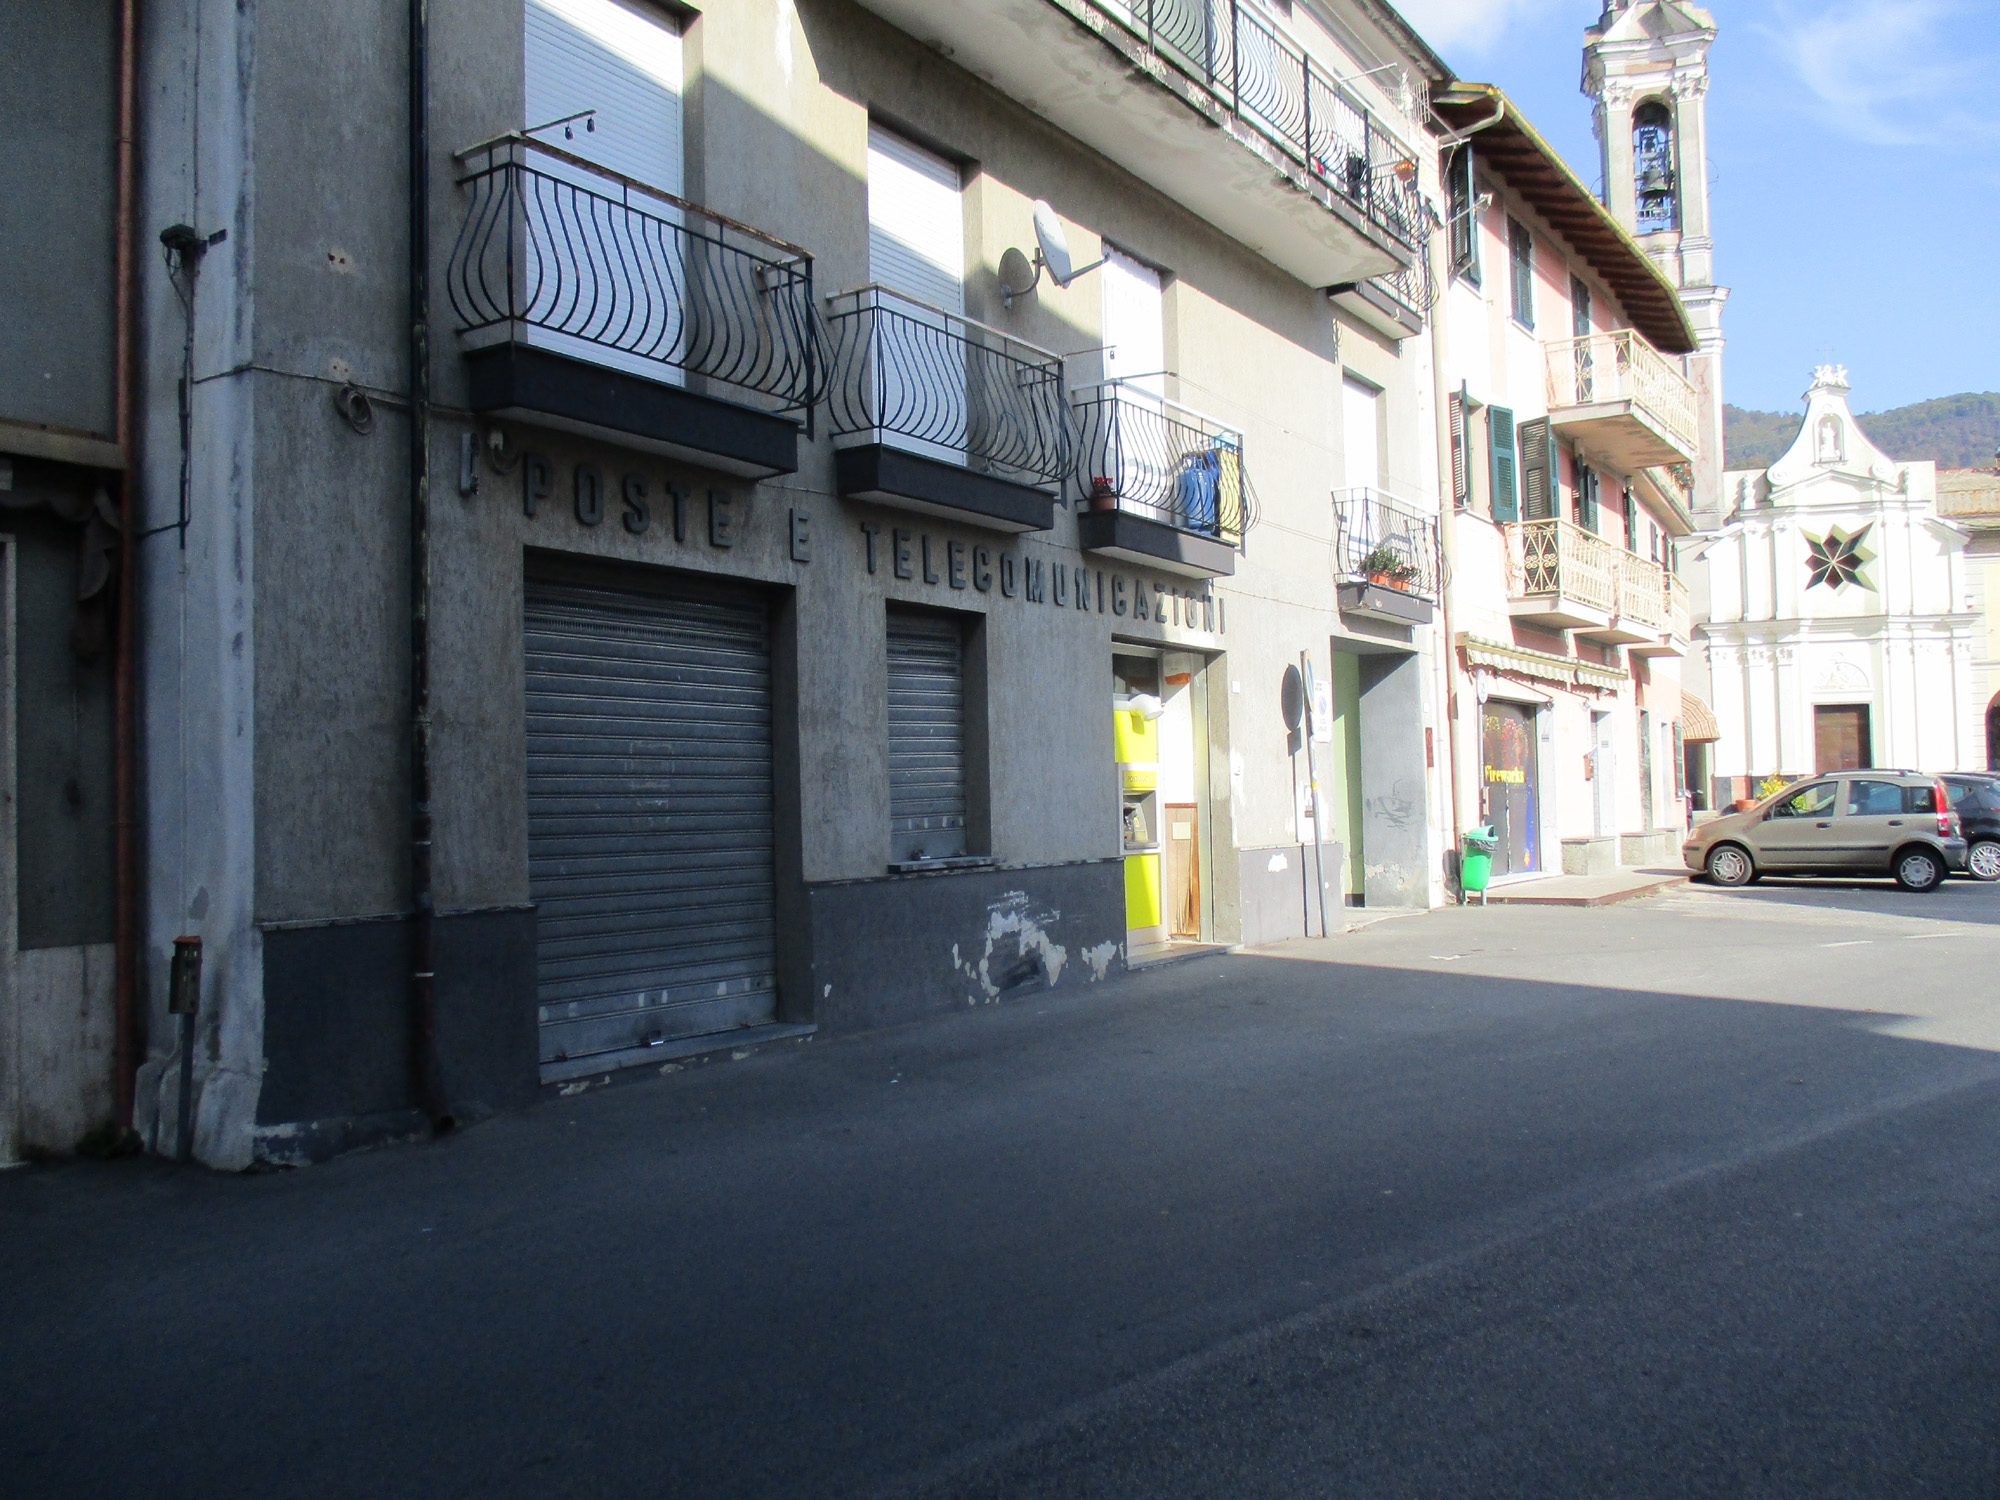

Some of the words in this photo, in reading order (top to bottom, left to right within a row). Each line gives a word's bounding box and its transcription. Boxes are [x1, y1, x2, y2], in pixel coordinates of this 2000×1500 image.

[522, 451, 734, 548] POSTE
[789, 507, 811, 563] E
[861, 521, 1226, 634] TELECOMUNICAZIONI
[1485, 764, 1525, 784] Fireworks
